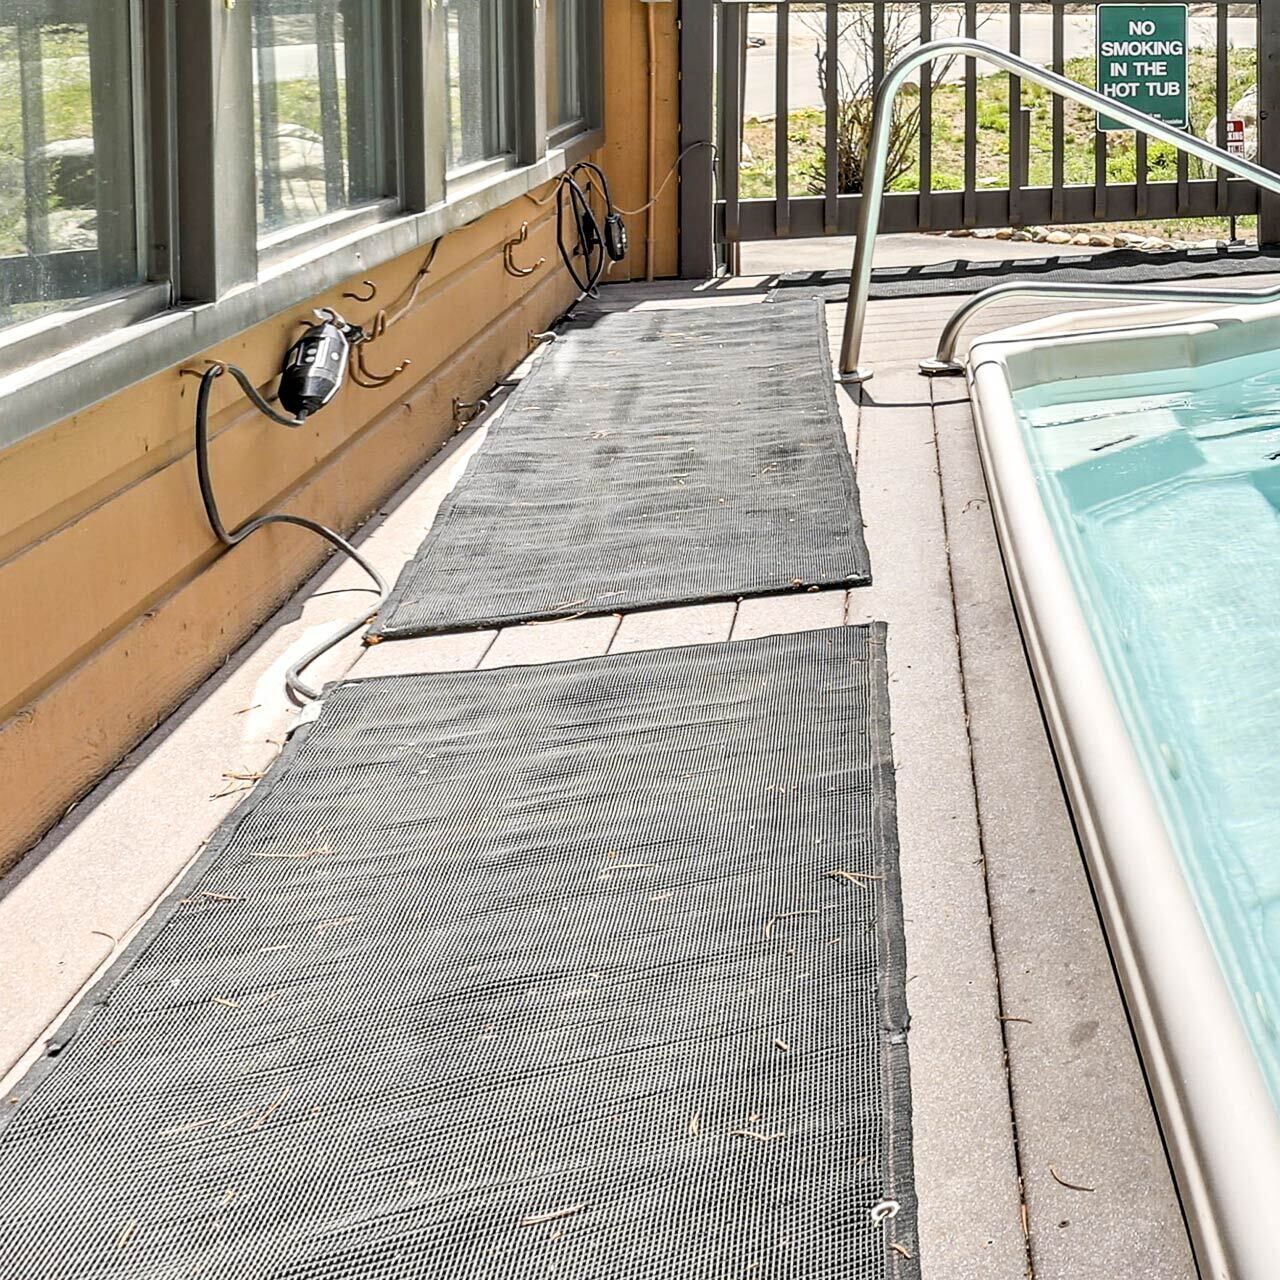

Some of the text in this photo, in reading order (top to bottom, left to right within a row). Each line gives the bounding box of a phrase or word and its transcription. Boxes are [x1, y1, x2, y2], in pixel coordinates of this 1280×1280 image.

[1129, 21, 1156, 36] NO
[1101, 41, 1183, 56] SMOKING
[1110, 62, 1167, 76] IN THE
[1103, 82, 1180, 97] HOT TUB
